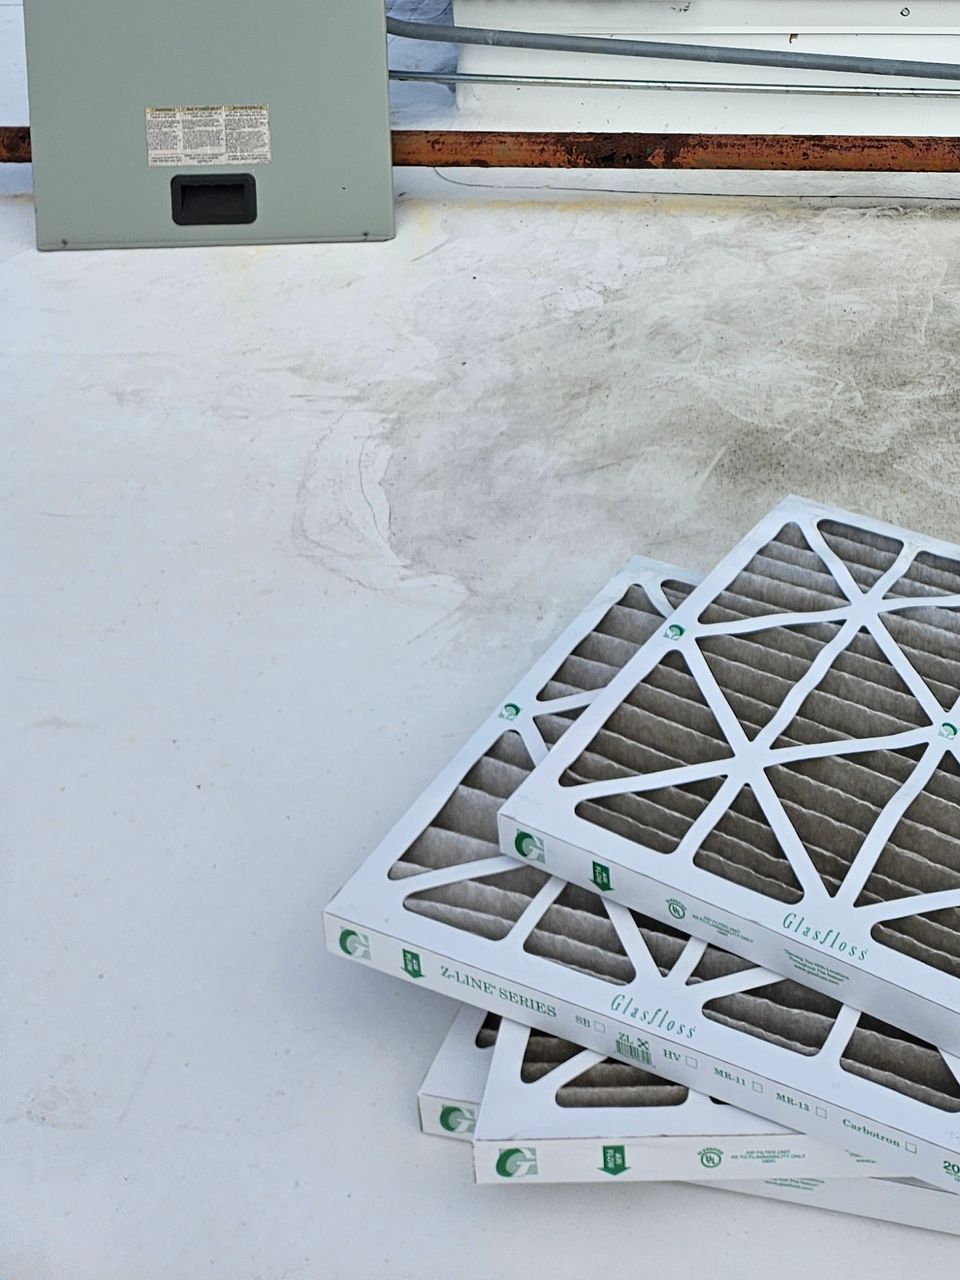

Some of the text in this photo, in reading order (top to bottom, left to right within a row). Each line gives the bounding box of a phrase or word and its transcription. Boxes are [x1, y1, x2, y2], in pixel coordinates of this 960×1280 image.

[782, 912, 867, 961] Glasfloss
[499, 987, 557, 1017] SERIES
[611, 993, 695, 1039] Glasfloss
[663, 1048, 682, 1062] HV
[714, 1067, 746, 1087] MR-11
[776, 1092, 810, 1112] MR-13
[842, 1118, 901, 1148] Carbotron
